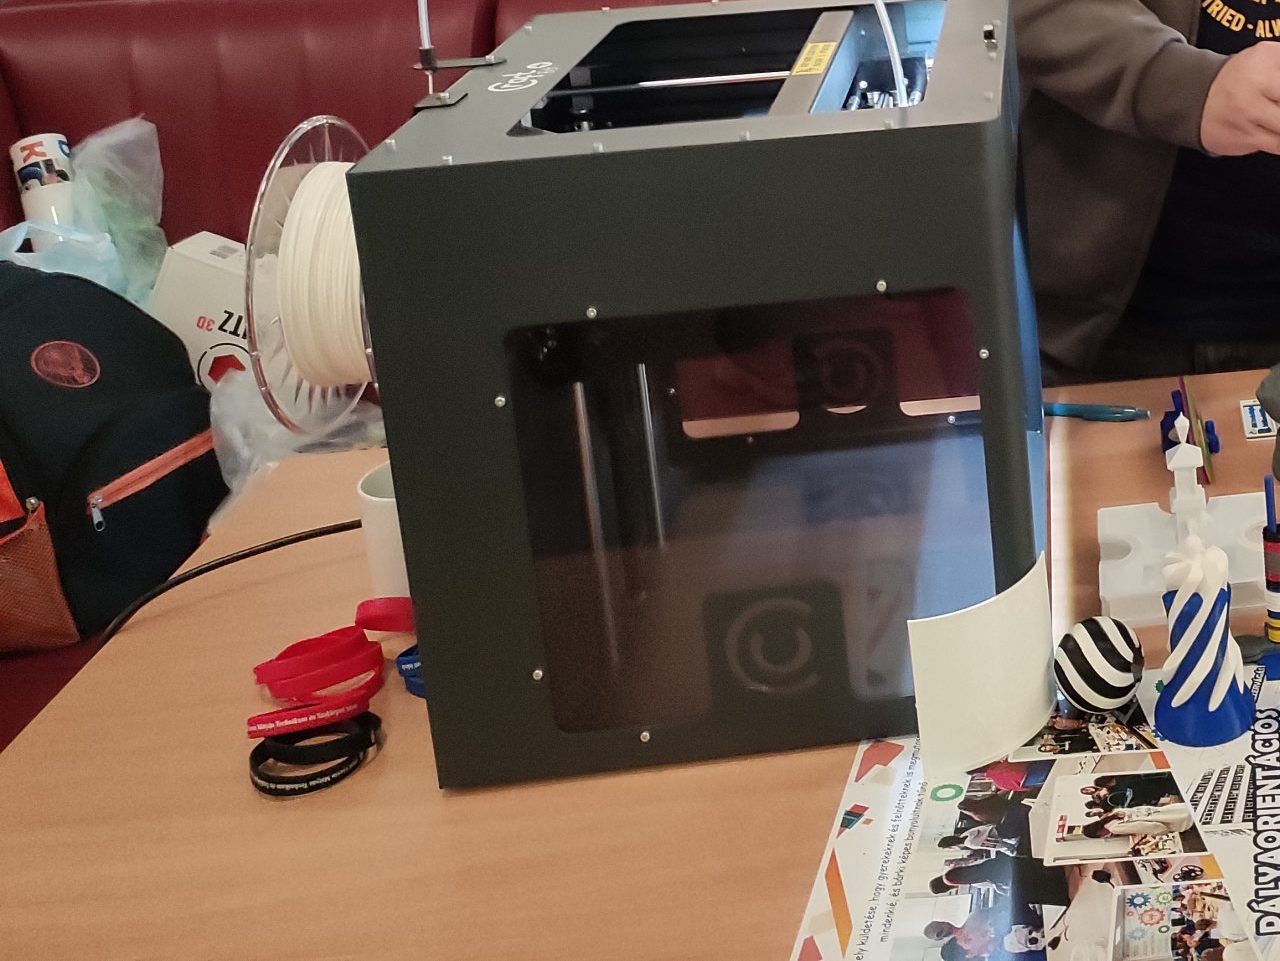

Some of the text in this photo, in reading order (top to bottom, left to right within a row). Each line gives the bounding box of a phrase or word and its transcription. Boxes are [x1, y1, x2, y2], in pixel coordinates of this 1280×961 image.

[197, 316, 215, 332] 3D
[903, 771, 914, 779] is
[890, 779, 911, 823] felnőtteknek
[884, 823, 900, 833] és
[903, 798, 923, 841] bonyolultnak
[876, 834, 898, 881] gyerekeknek
[897, 842, 912, 865] képes
[893, 866, 906, 887] bárki
[868, 882, 886, 902] hogy
[888, 888, 901, 898] és
